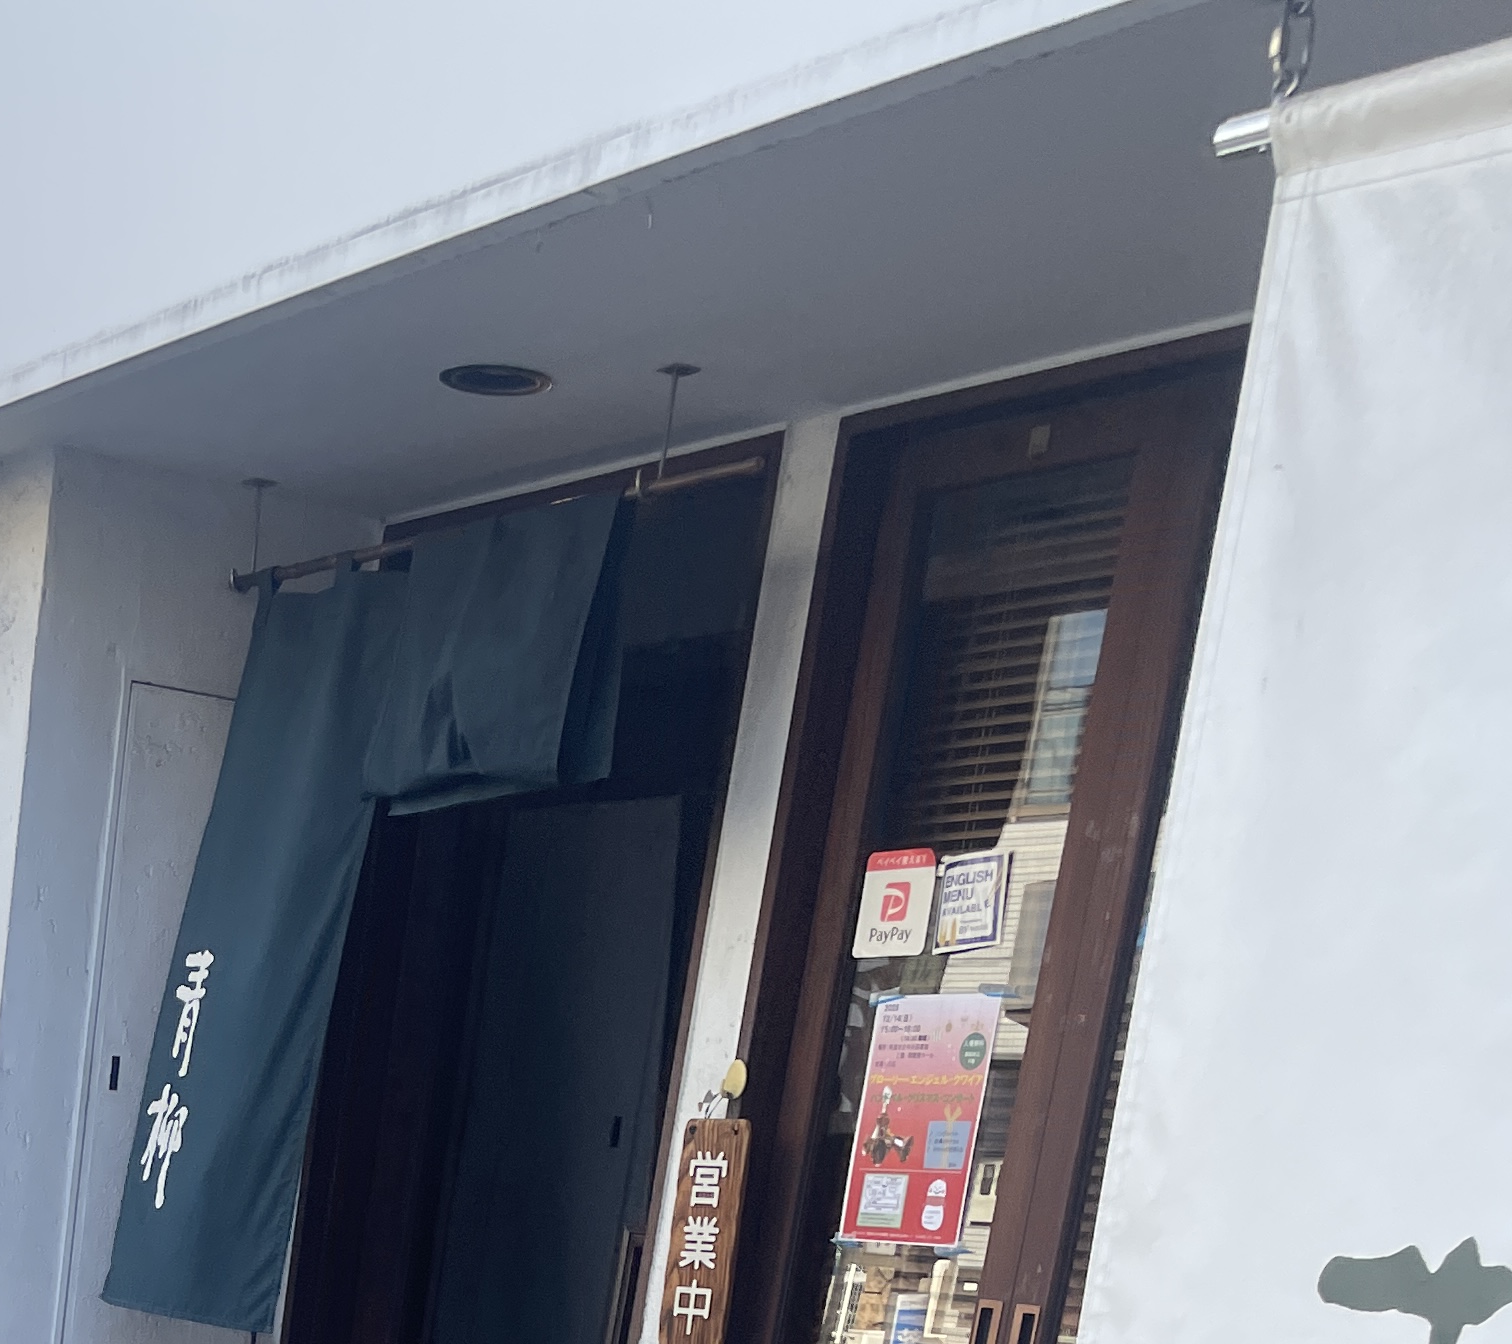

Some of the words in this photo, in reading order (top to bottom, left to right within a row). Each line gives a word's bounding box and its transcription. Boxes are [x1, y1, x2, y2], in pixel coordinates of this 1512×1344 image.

[945, 868, 994, 889] ENGLISH
[942, 886, 975, 904] MENU
[941, 898, 992, 917] AVAILABLE
[868, 926, 913, 945] PayPay
[140, 949, 215, 1209] 青柳
[670, 1149, 731, 1338] 営業中
